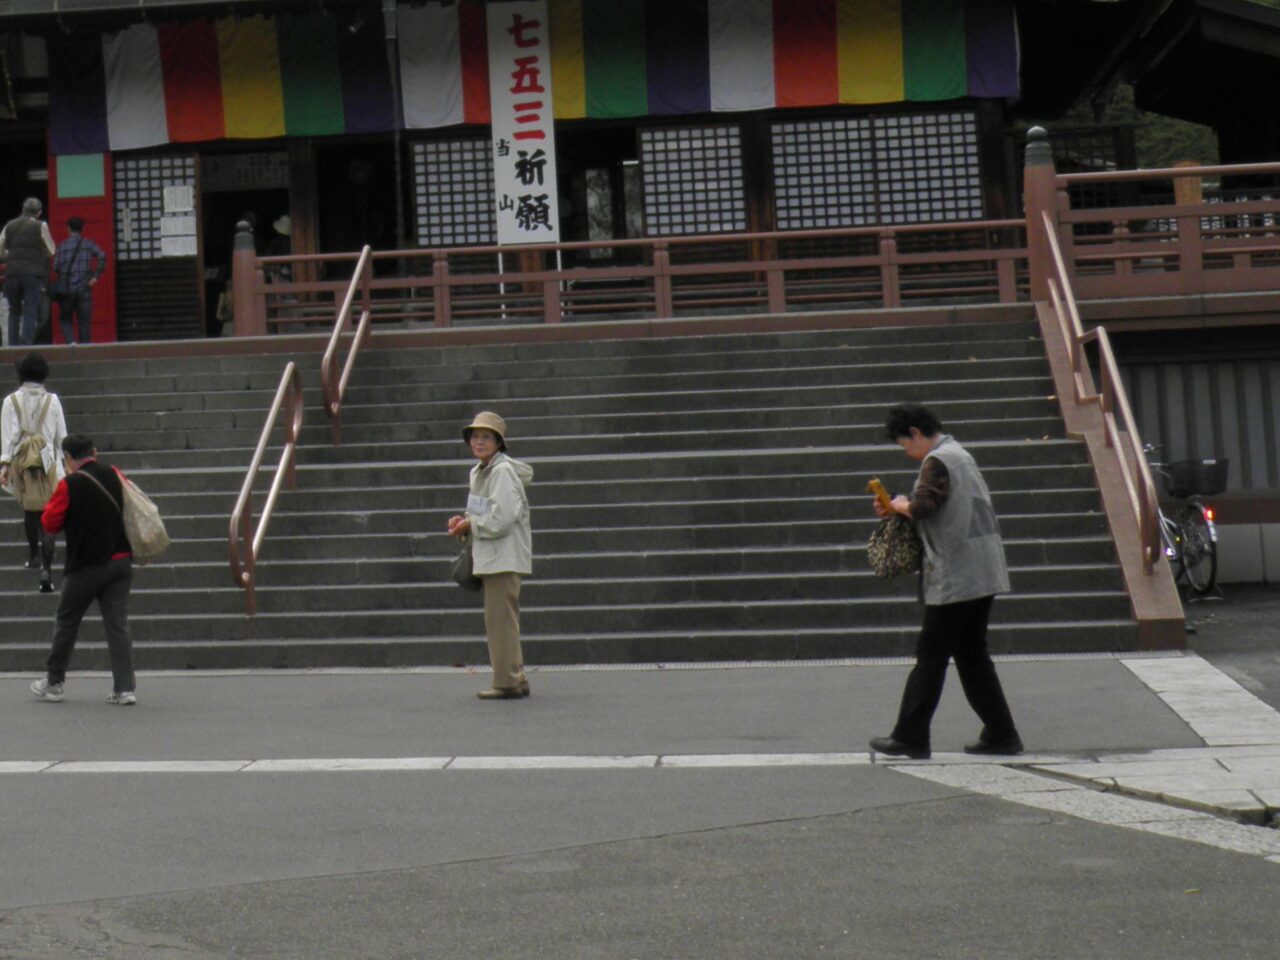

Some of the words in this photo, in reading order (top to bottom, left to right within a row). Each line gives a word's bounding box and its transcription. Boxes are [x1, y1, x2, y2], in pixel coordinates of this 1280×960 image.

[506, 13, 553, 231] 七五三祈願
